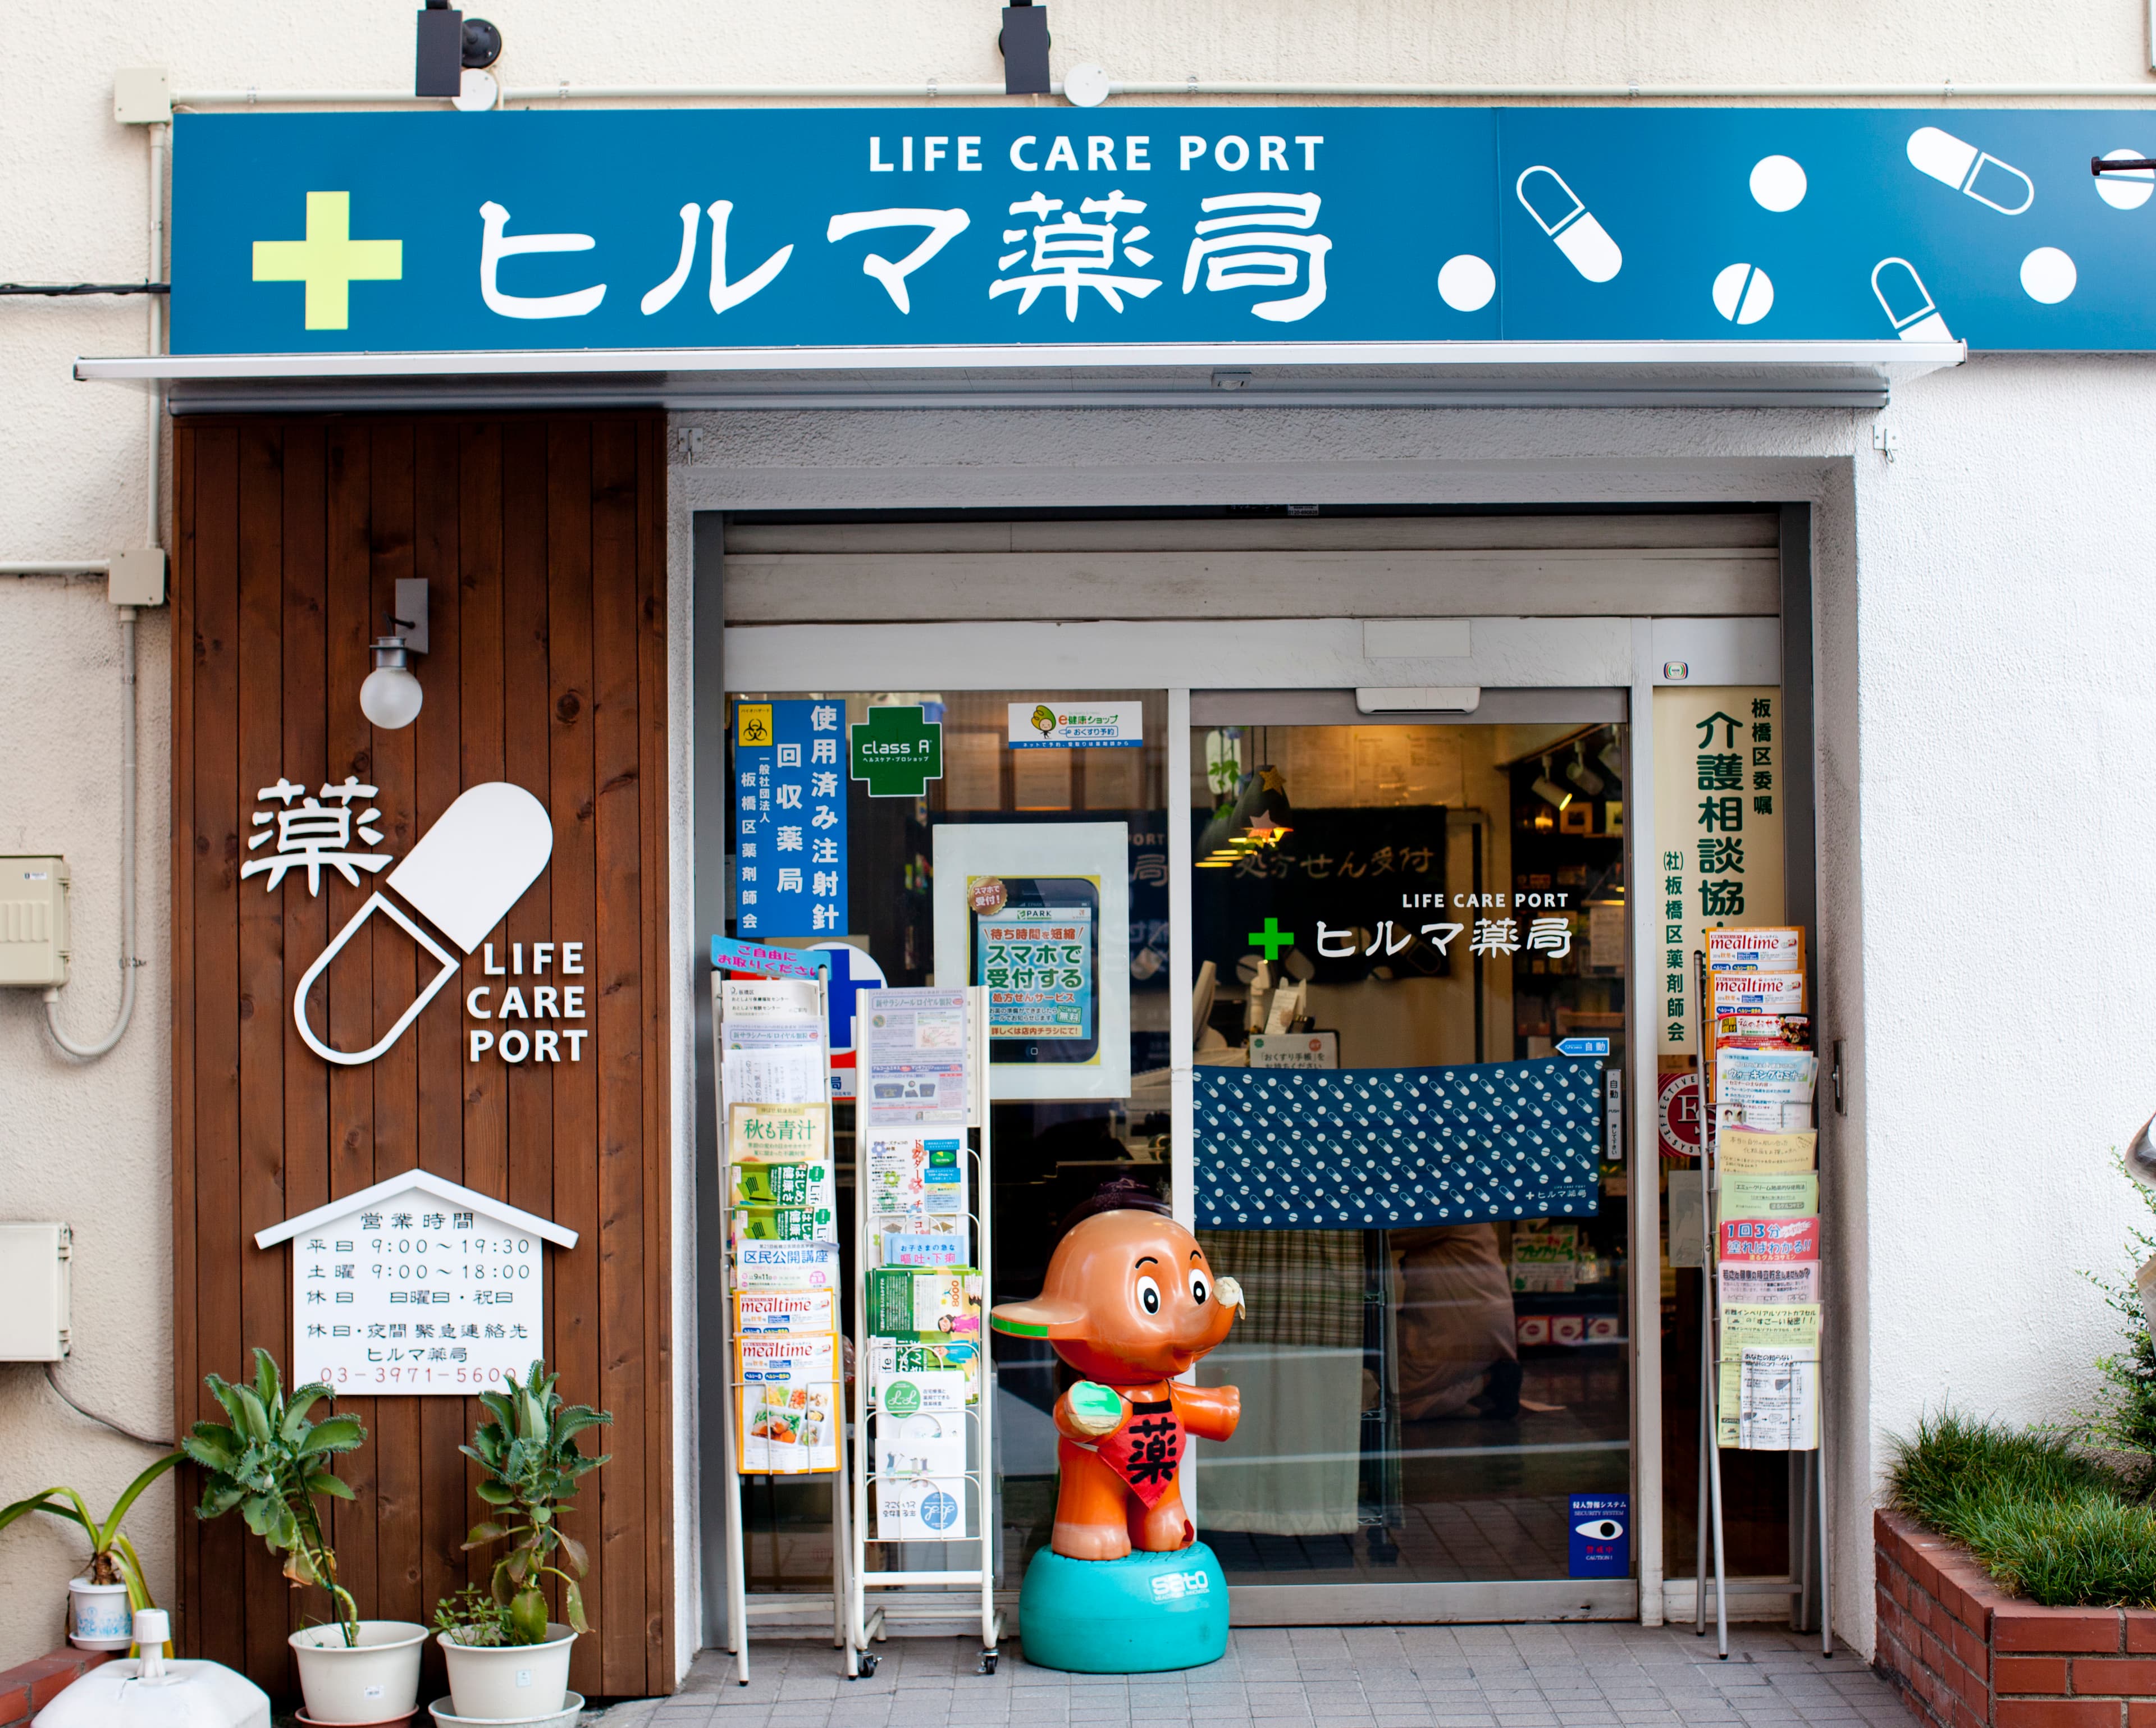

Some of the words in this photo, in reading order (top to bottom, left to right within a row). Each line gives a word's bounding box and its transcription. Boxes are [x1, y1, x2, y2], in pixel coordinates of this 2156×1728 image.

[870, 136, 983, 172] LIFE
[1010, 136, 1150, 172] CARE
[1180, 136, 1324, 172] PORT
[479, 189, 1332, 323] ヒルマ薬局
[1058, 714, 1118, 726] e健康ショップ
[1074, 728, 1114, 737] おくすり予約
[862, 740, 910, 755] class
[919, 739, 929, 754] A
[1751, 698, 1773, 815] 板橋区委嘱
[759, 757, 770, 824] 一般社団法人
[776, 743, 803, 894] 回収薬局
[811, 705, 839, 930] 使用済み注射針
[1696, 711, 1744, 933] 介護相談協
[240, 775, 394, 898] 薬
[741, 772, 757, 929] 板橋区薬剤師会
[1235, 845, 1435, 879] 処方せん受付
[1403, 893, 1445, 908] LIFE
[1454, 893, 1506, 908] CARE
[1515, 893, 1568, 908] PORT
[990, 928, 1076, 940] 待ち時間を短縮
[1316, 917, 1572, 959] ヒルマ薬局
[1711, 935, 1779, 949] mealtime
[484, 942, 584, 975] LIFE
[737, 945, 797, 962] ご自由に
[987, 945, 1082, 964] スマホで
[986, 968, 1082, 989] 受付する
[1715, 978, 1783, 992] mealtime
[467, 986, 586, 1020] CARE
[992, 993, 1075, 1003] 処方せんサービス
[470, 1029, 588, 1063] PORT
[1585, 1042, 1606, 1052] 自動
[1610, 1080, 1619, 1099] 自動
[743, 1118, 817, 1140] 秋も青汁
[782, 1166, 794, 1205] 健康さ
[794, 1167, 806, 1205] はじめ
[362, 1212, 474, 1230] 営業時間
[307, 1239, 354, 1254] 平日
[744, 1250, 829, 1264] 区民公開講座
[307, 1264, 355, 1279] 土曜
[307, 1290, 354, 1305] 休日
[390, 1290, 514, 1305] 日曜日・祝日
[741, 1297, 811, 1313] mealtime
[368, 1348, 468, 1363] ヒルマ薬局
[743, 1342, 812, 1357] mealtime
[1127, 1416, 1177, 1485] 薬
